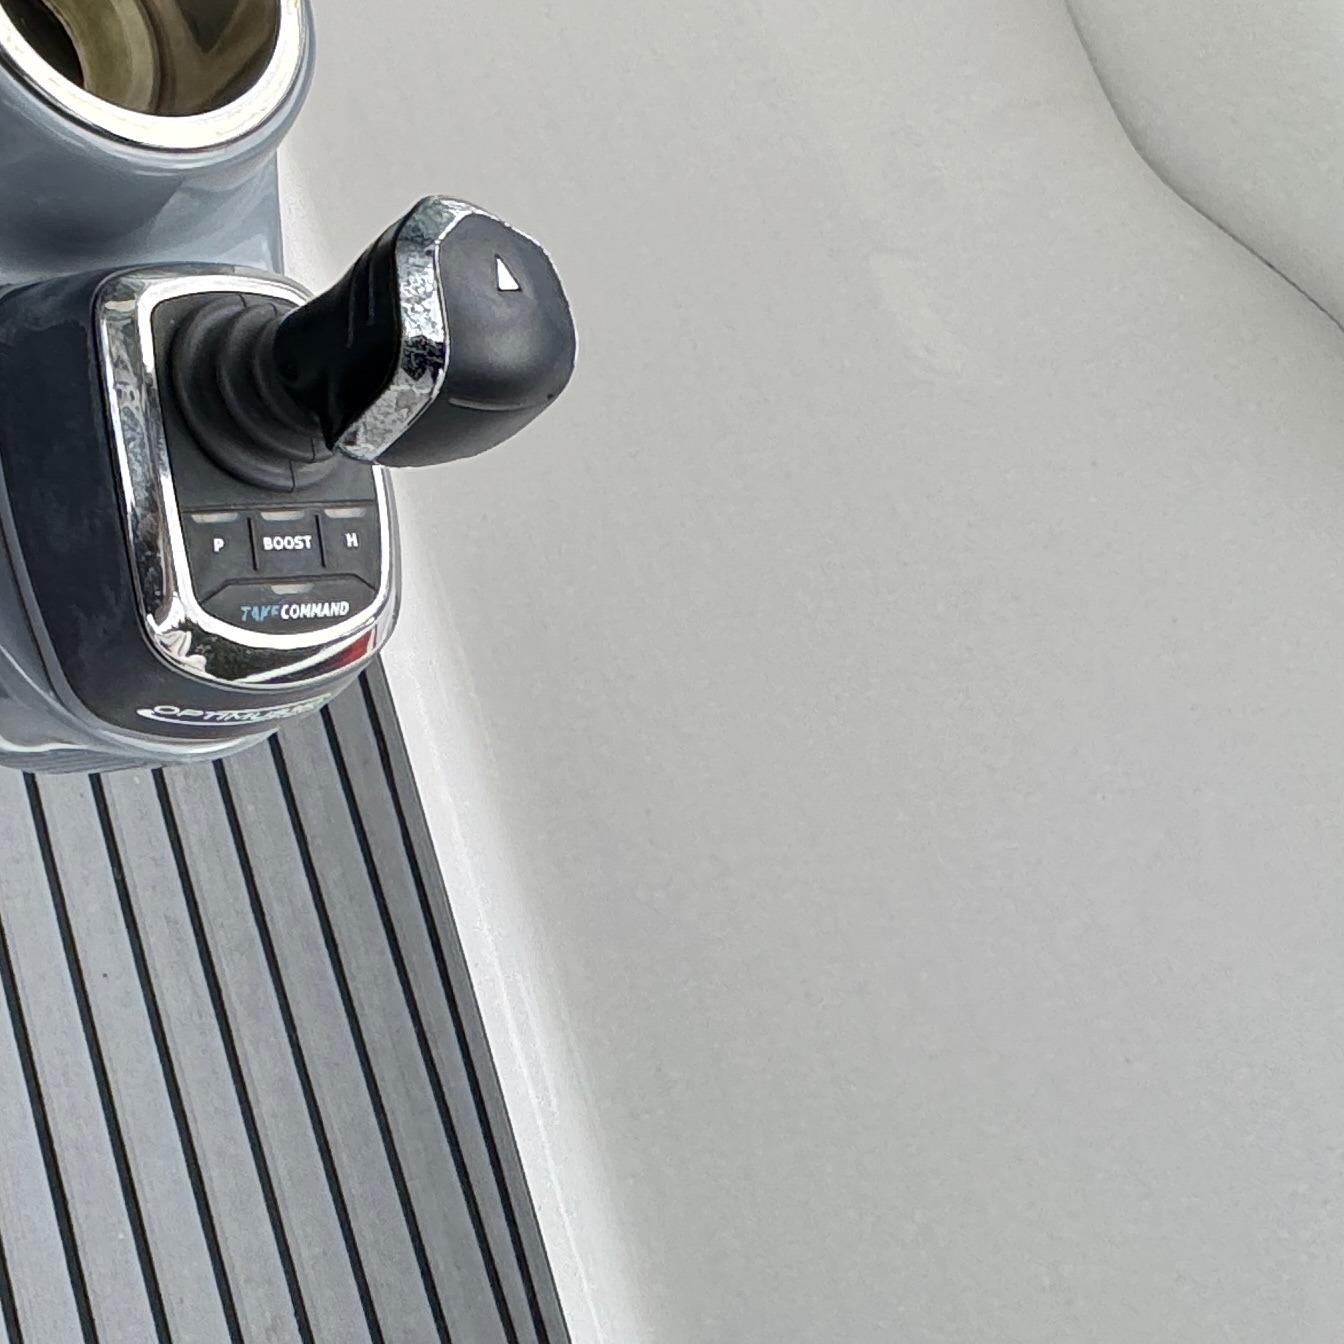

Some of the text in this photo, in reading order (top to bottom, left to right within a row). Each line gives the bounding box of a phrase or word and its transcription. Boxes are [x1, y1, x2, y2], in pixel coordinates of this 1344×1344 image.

[213, 537, 225, 553] P
[262, 535, 313, 551] BOOST
[345, 532, 359, 548] H
